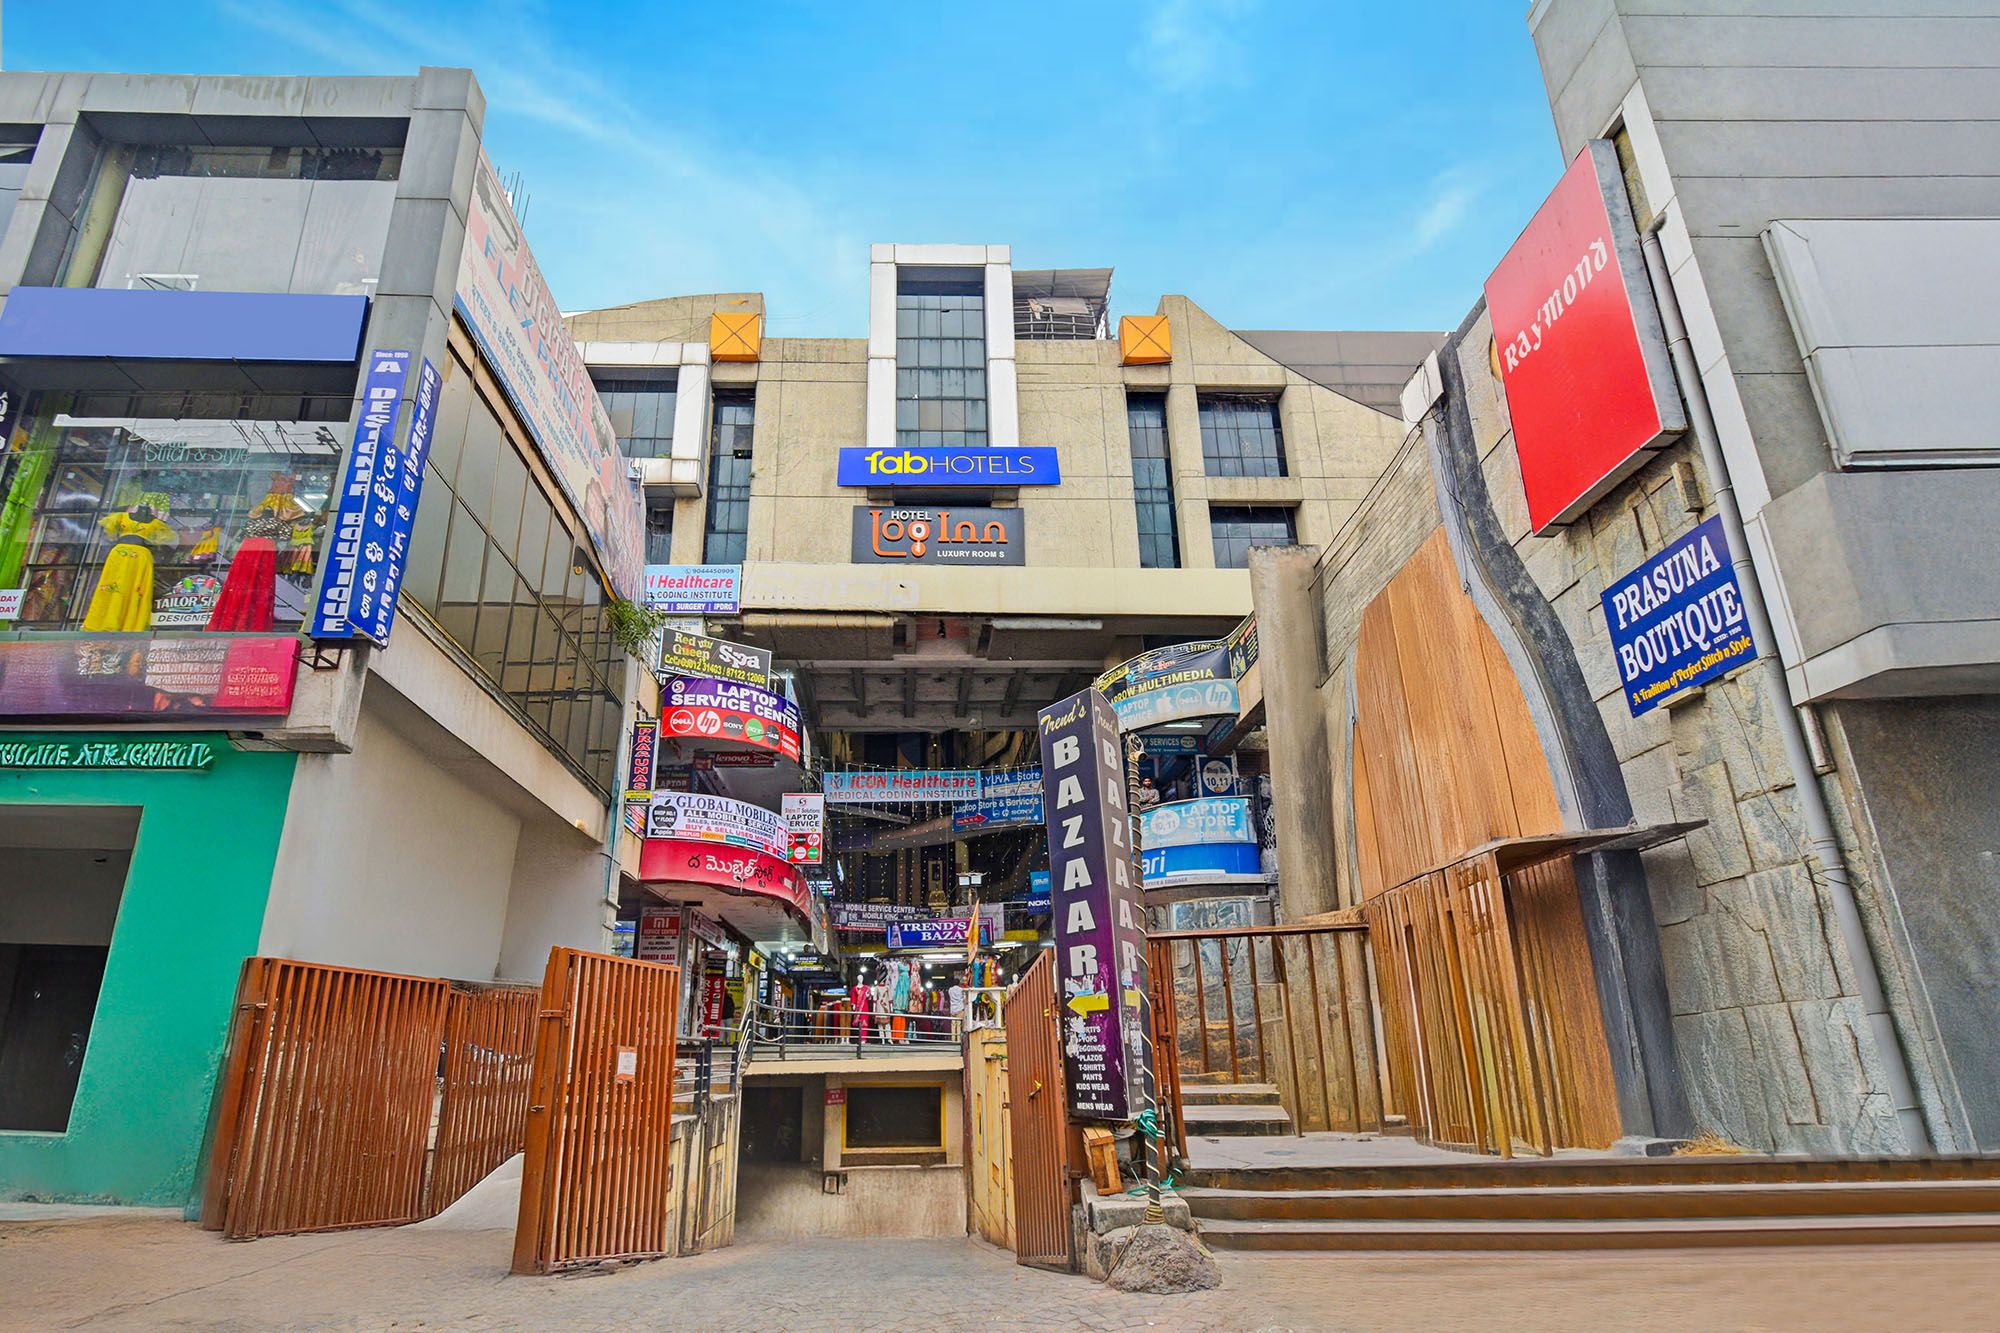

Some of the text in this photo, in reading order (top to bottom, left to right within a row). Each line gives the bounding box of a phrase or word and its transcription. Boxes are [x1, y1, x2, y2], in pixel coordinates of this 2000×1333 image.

[1504, 237, 1608, 373] Raymond
[485, 234, 534, 342] FLEX
[537, 338, 601, 476] PRINTING
[374, 361, 401, 373] A
[864, 450, 1035, 474] fabHOTELS
[891, 511, 932, 521] HOTEL
[937, 511, 1008, 543] Inn
[657, 575, 734, 589] Healthcare
[1612, 535, 1721, 630] PRASUNA
[657, 591, 733, 599] CODING INSTITUTE
[155, 596, 198, 609] TAILOR
[674, 632, 696, 647] Red
[1619, 582, 1743, 683] BOUTIQUE
[719, 645, 760, 669] Spa
[1633, 692, 1641, 706] A
[1641, 681, 1670, 701] Tradition
[1670, 672, 1678, 687] of
[1677, 660, 1702, 683] Perfect
[1702, 651, 1724, 671] Stitch
[1731, 635, 1752, 656] Style
[1138, 668, 1214, 693] MULTIMEDIA
[717, 684, 777, 707] LAPTOP
[671, 694, 750, 712] SERVICE
[754, 705, 798, 733] CENTER
[1041, 698, 1087, 736] Trend's
[723, 722, 743, 730] SONY
[1150, 737, 1179, 746] SERVICES
[716, 754, 750, 762] lenovo
[850, 775, 888, 789] ICON
[892, 774, 976, 789] Healthcare
[1017, 772, 1040, 781] Store
[829, 789, 977, 800] MEDICAL CODING INSTITUTE
[676, 796, 777, 827] GLOBAL MOBILES
[955, 804, 977, 813] Laptop
[979, 801, 997, 810] Store
[1181, 803, 1240, 817] LAPTOP
[686, 810, 705, 818] ALL
[707, 812, 746, 824] MOBILES
[747, 821, 776, 834] SERVICE
[1187, 815, 1236, 829] STORE
[714, 826, 734, 834] SELL
[736, 830, 753, 838] USED
[1052, 735, 1099, 977] BAZAAR
[1102, 738, 1138, 973] BAZAAR
[846, 904, 868, 912] MOBILE
[893, 905, 915, 914] CENTER
[901, 922, 966, 931] TREND'S
[922, 931, 968, 941] BAZA
[1082, 1073, 1103, 1081] PANTS
[1076, 1083, 1110, 1091] KIDS WEAR
[1095, 1103, 1114, 1111] WEAR
